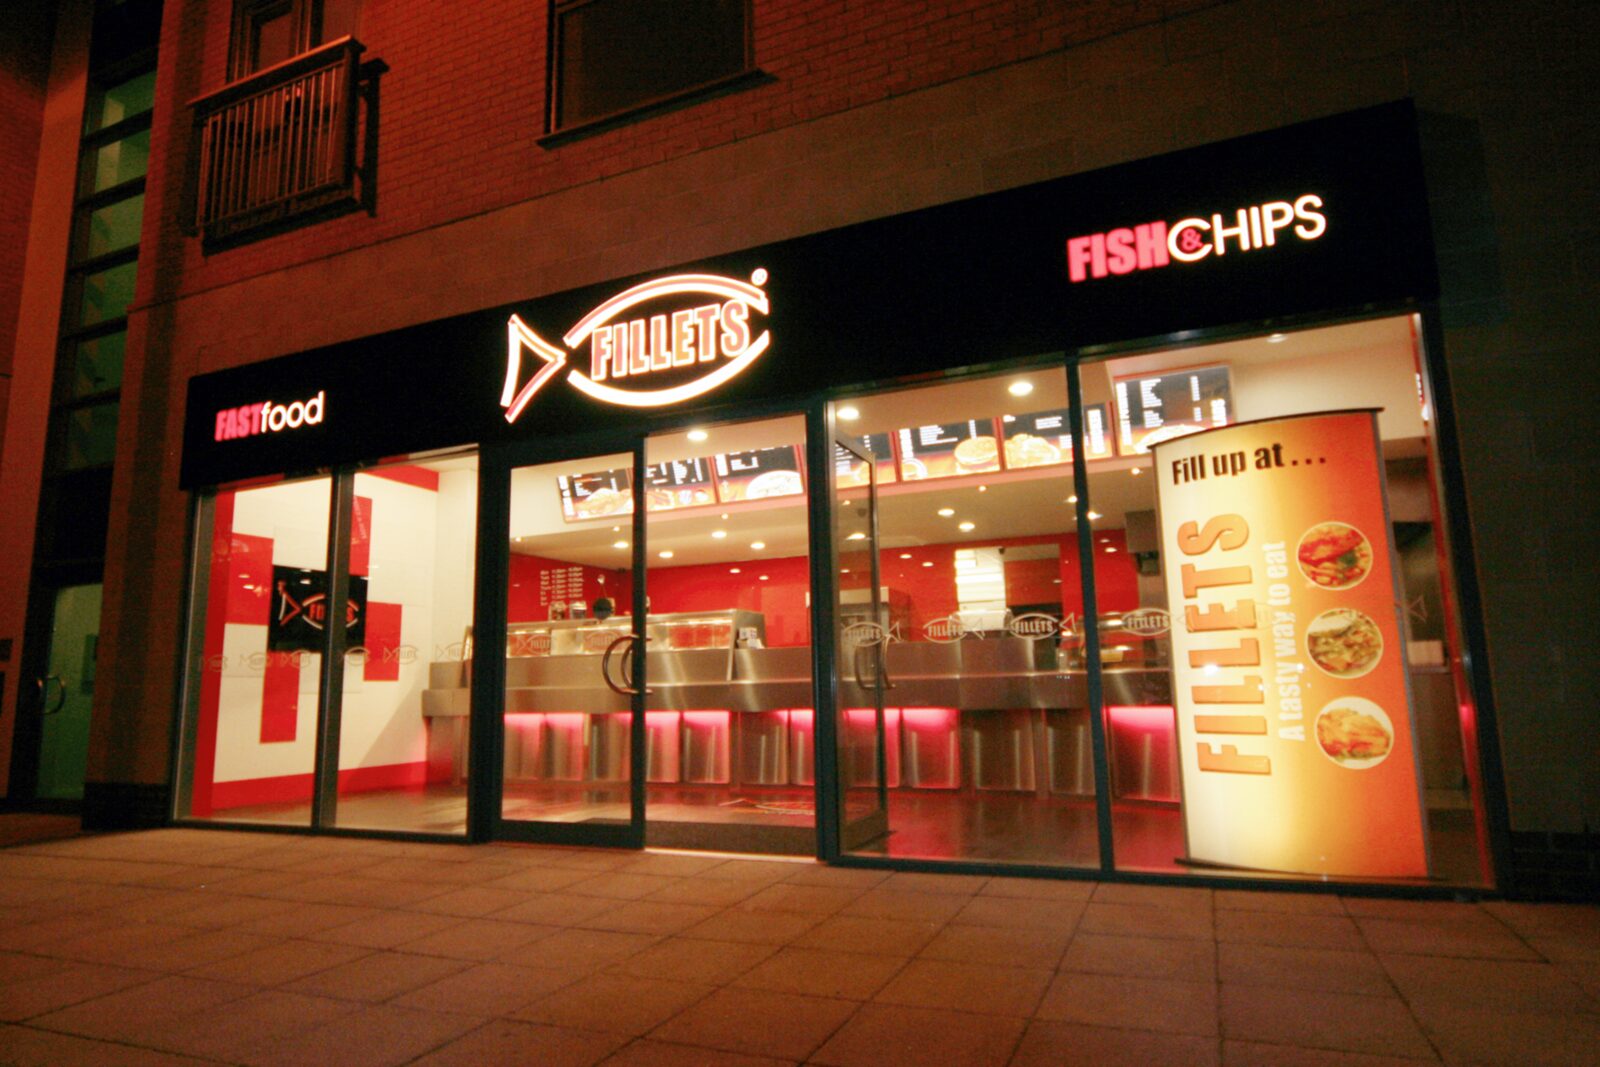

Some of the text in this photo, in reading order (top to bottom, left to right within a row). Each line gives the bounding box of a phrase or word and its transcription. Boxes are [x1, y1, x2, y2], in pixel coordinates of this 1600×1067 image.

[1066, 220, 1169, 283] FISH
[1167, 194, 1327, 262] CHIPS
[591, 299, 750, 382] FILLETS
[1172, 454, 1206, 485] Fill
[1212, 451, 1246, 476] up
[1263, 540, 1288, 579] eat
[1267, 583, 1291, 606] to
[1015, 620, 1053, 634] FILLETS
[1177, 513, 1272, 776] FILLETS
[1272, 611, 1296, 657] way
[1275, 661, 1303, 721] tasty
[1279, 725, 1305, 741] A
